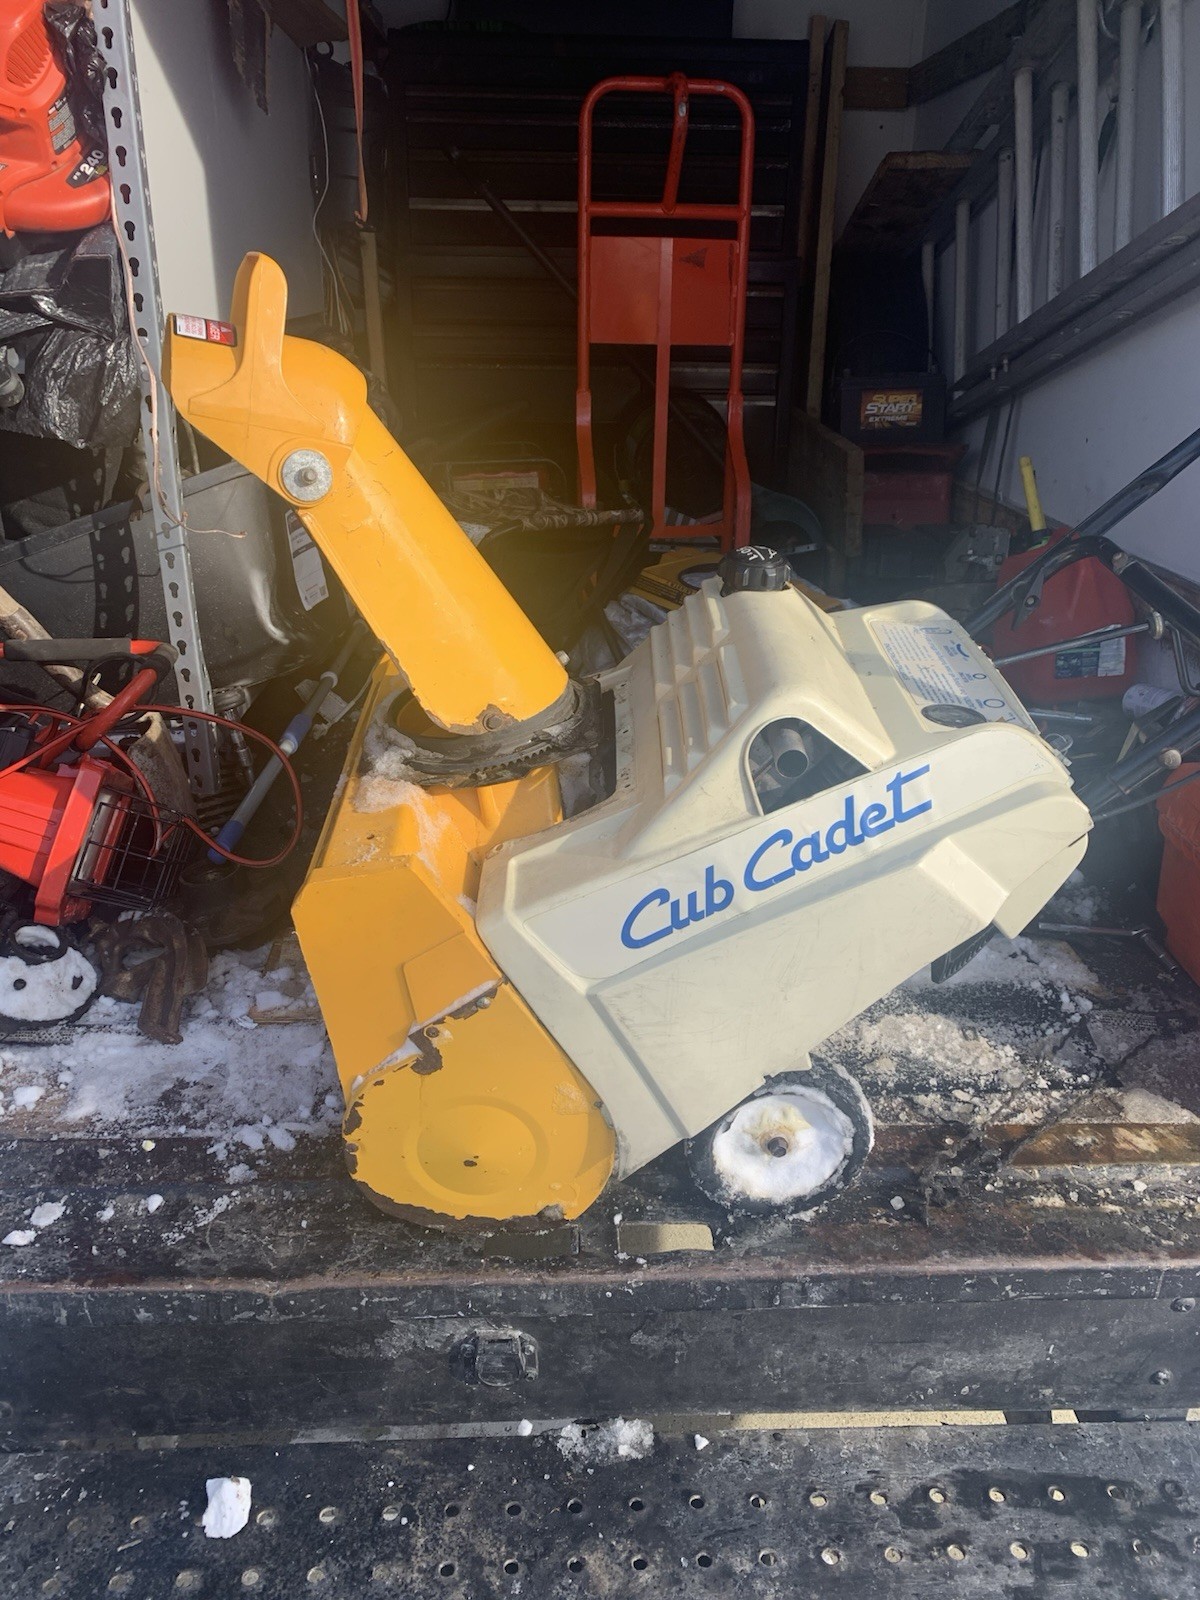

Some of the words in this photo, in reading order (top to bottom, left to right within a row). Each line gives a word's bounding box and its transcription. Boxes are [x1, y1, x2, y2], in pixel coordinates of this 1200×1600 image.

[80, 149, 104, 175] 240
[865, 402, 917, 414] START
[868, 415, 908, 423] EXTREME
[620, 864, 735, 949] Cub
[743, 764, 932, 892] Cadet
